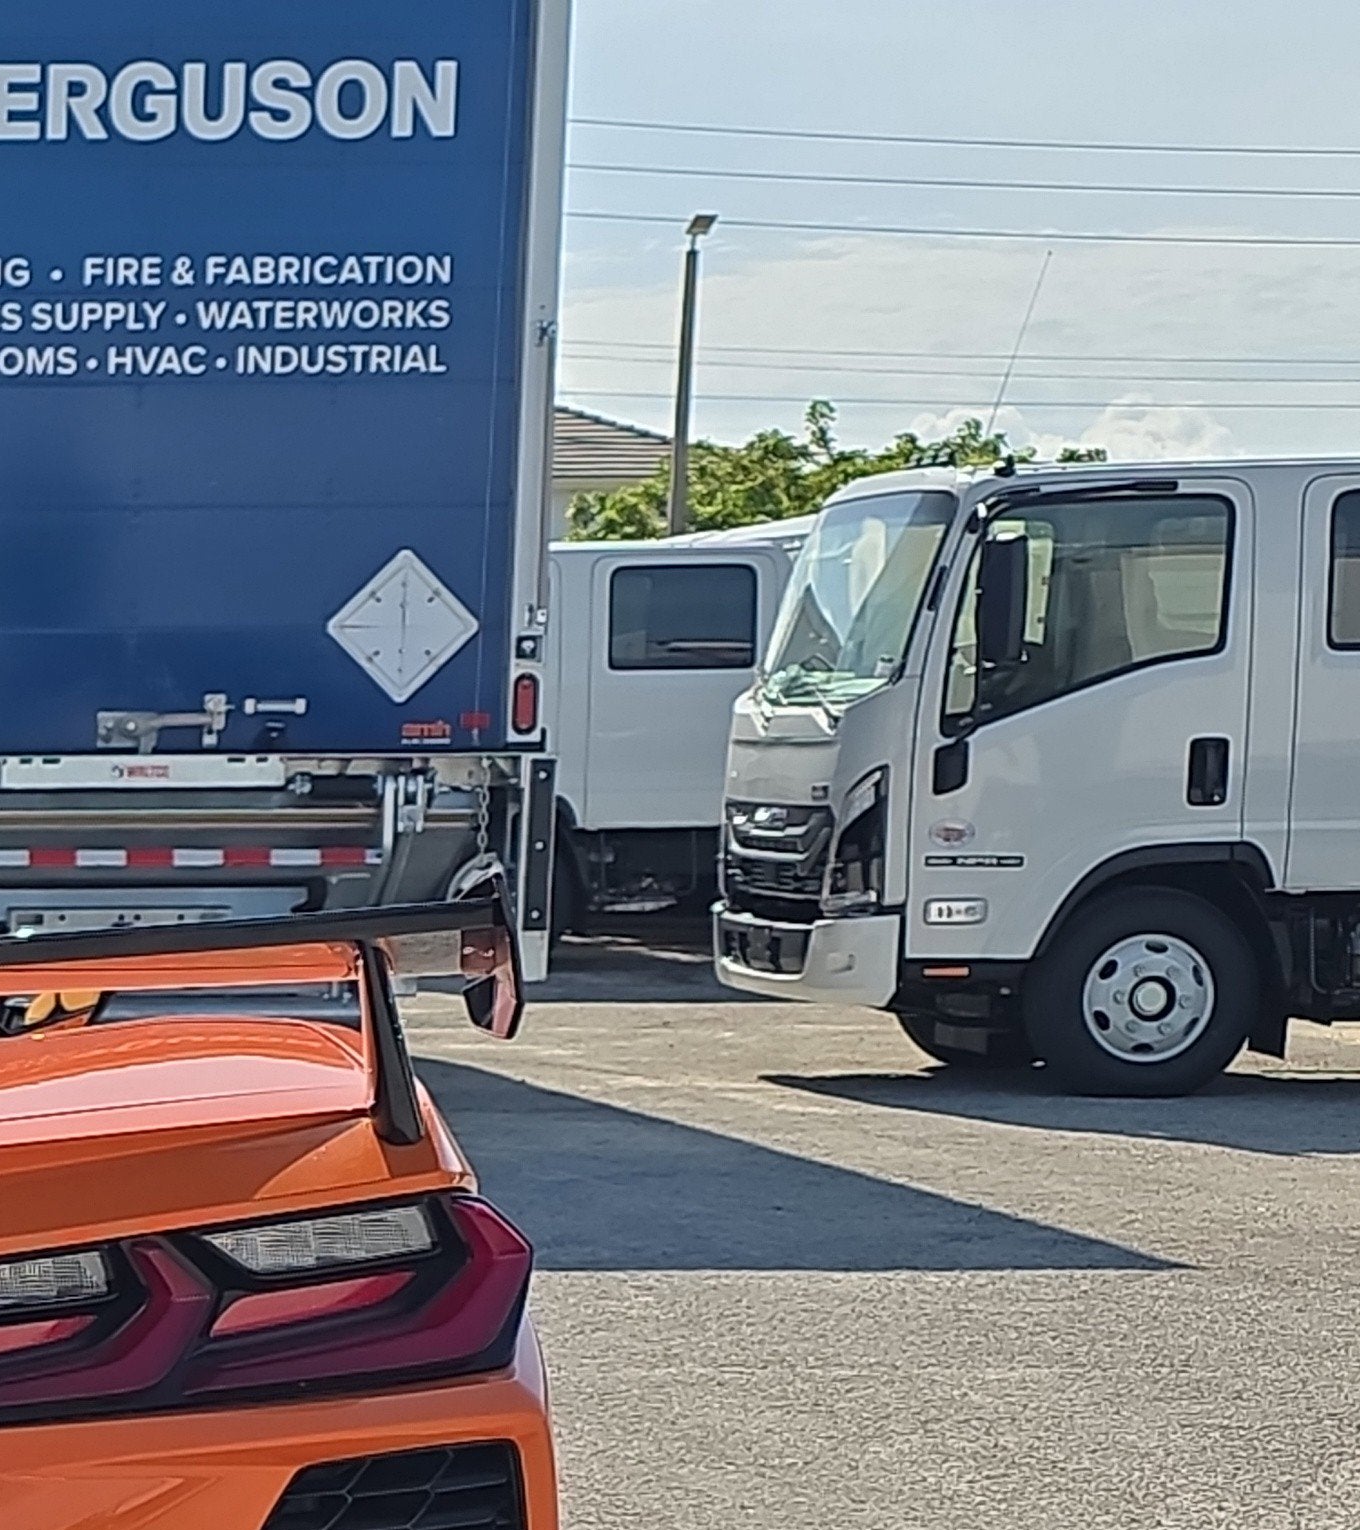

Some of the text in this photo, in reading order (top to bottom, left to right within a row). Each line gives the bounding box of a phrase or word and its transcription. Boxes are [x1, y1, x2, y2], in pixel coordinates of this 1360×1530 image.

[82, 257, 162, 287] FIRE
[170, 255, 196, 285] &
[204, 254, 452, 286] FABRICATION
[30, 300, 168, 332] SUPPLY
[196, 299, 452, 330] WATERWORKS
[106, 346, 208, 376] HVAC
[235, 344, 448, 374] INDUSTRIAL
